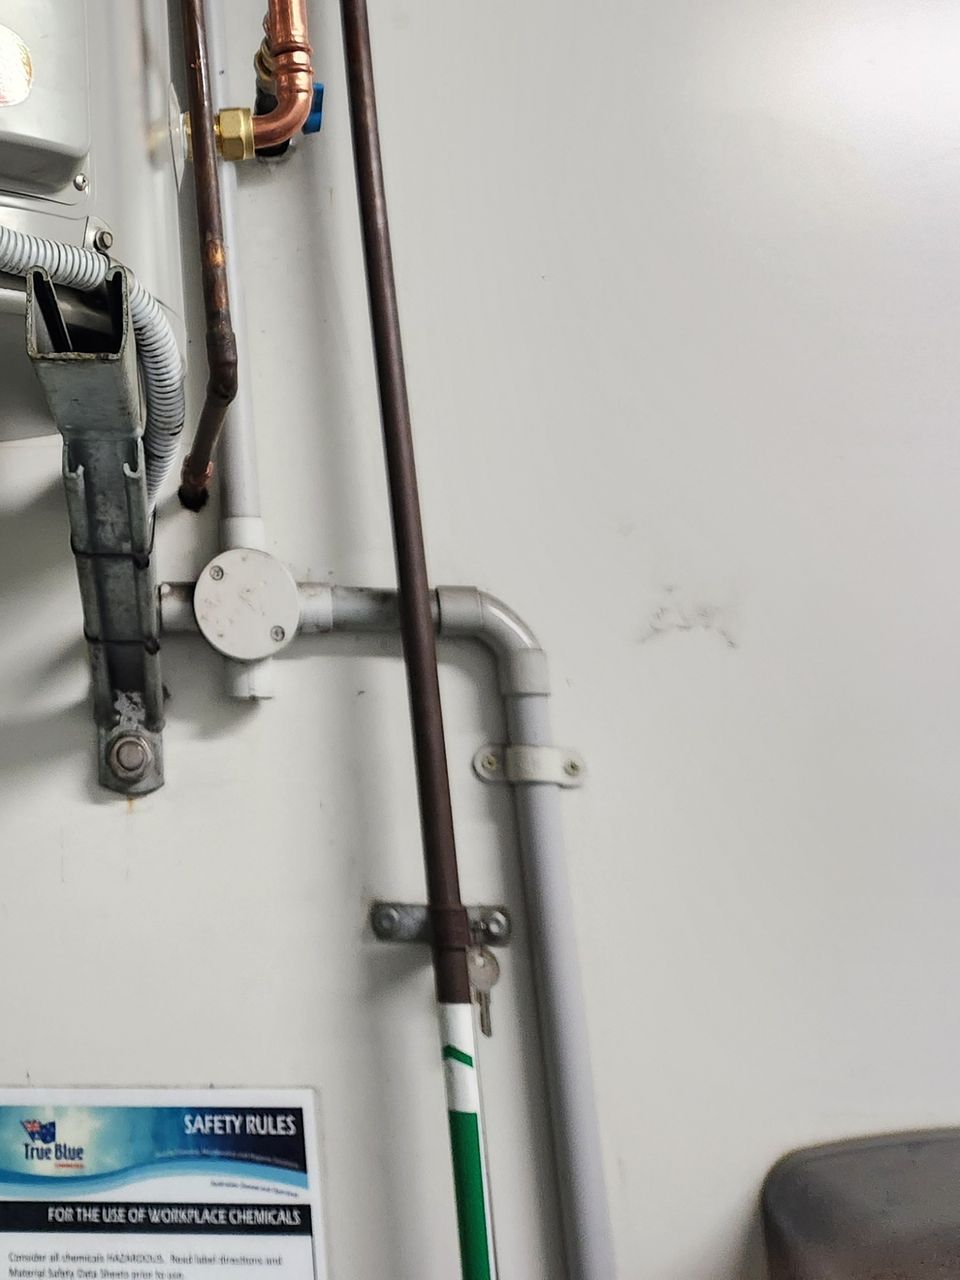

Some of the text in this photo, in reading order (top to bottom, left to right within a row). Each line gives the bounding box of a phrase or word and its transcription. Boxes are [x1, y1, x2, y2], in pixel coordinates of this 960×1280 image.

[184, 1114, 296, 1136] SAFETY RULES
[24, 1143, 84, 1160] True Blue
[47, 1207, 301, 1225] FOR THE USE OF WORKPLACE CHEMICALS
[8, 1252, 47, 1263] Consider
